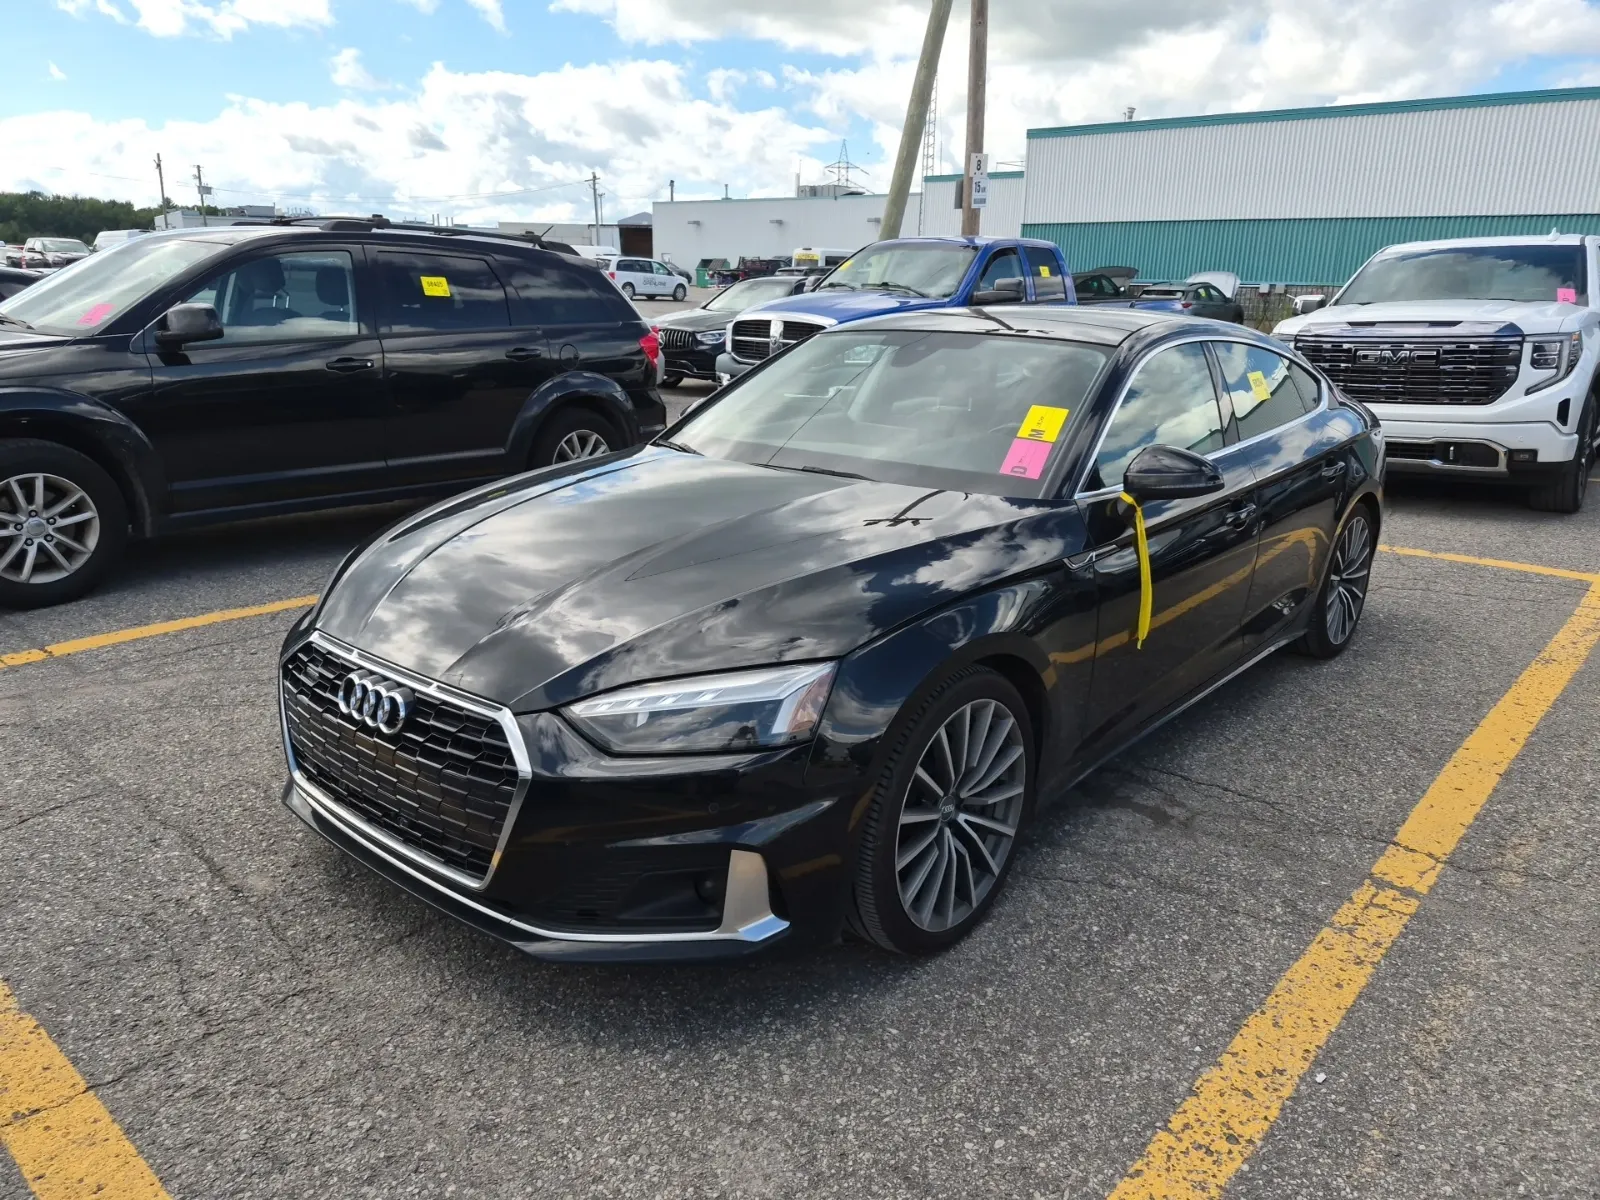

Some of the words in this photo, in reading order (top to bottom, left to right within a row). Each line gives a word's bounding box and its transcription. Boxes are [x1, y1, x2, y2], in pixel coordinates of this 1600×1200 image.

[976, 159, 982, 171] 8
[974, 181, 981, 193] 15
[1356, 350, 1437, 365] GMC
[1028, 428, 1046, 439] M
[1010, 465, 1028, 475] D
